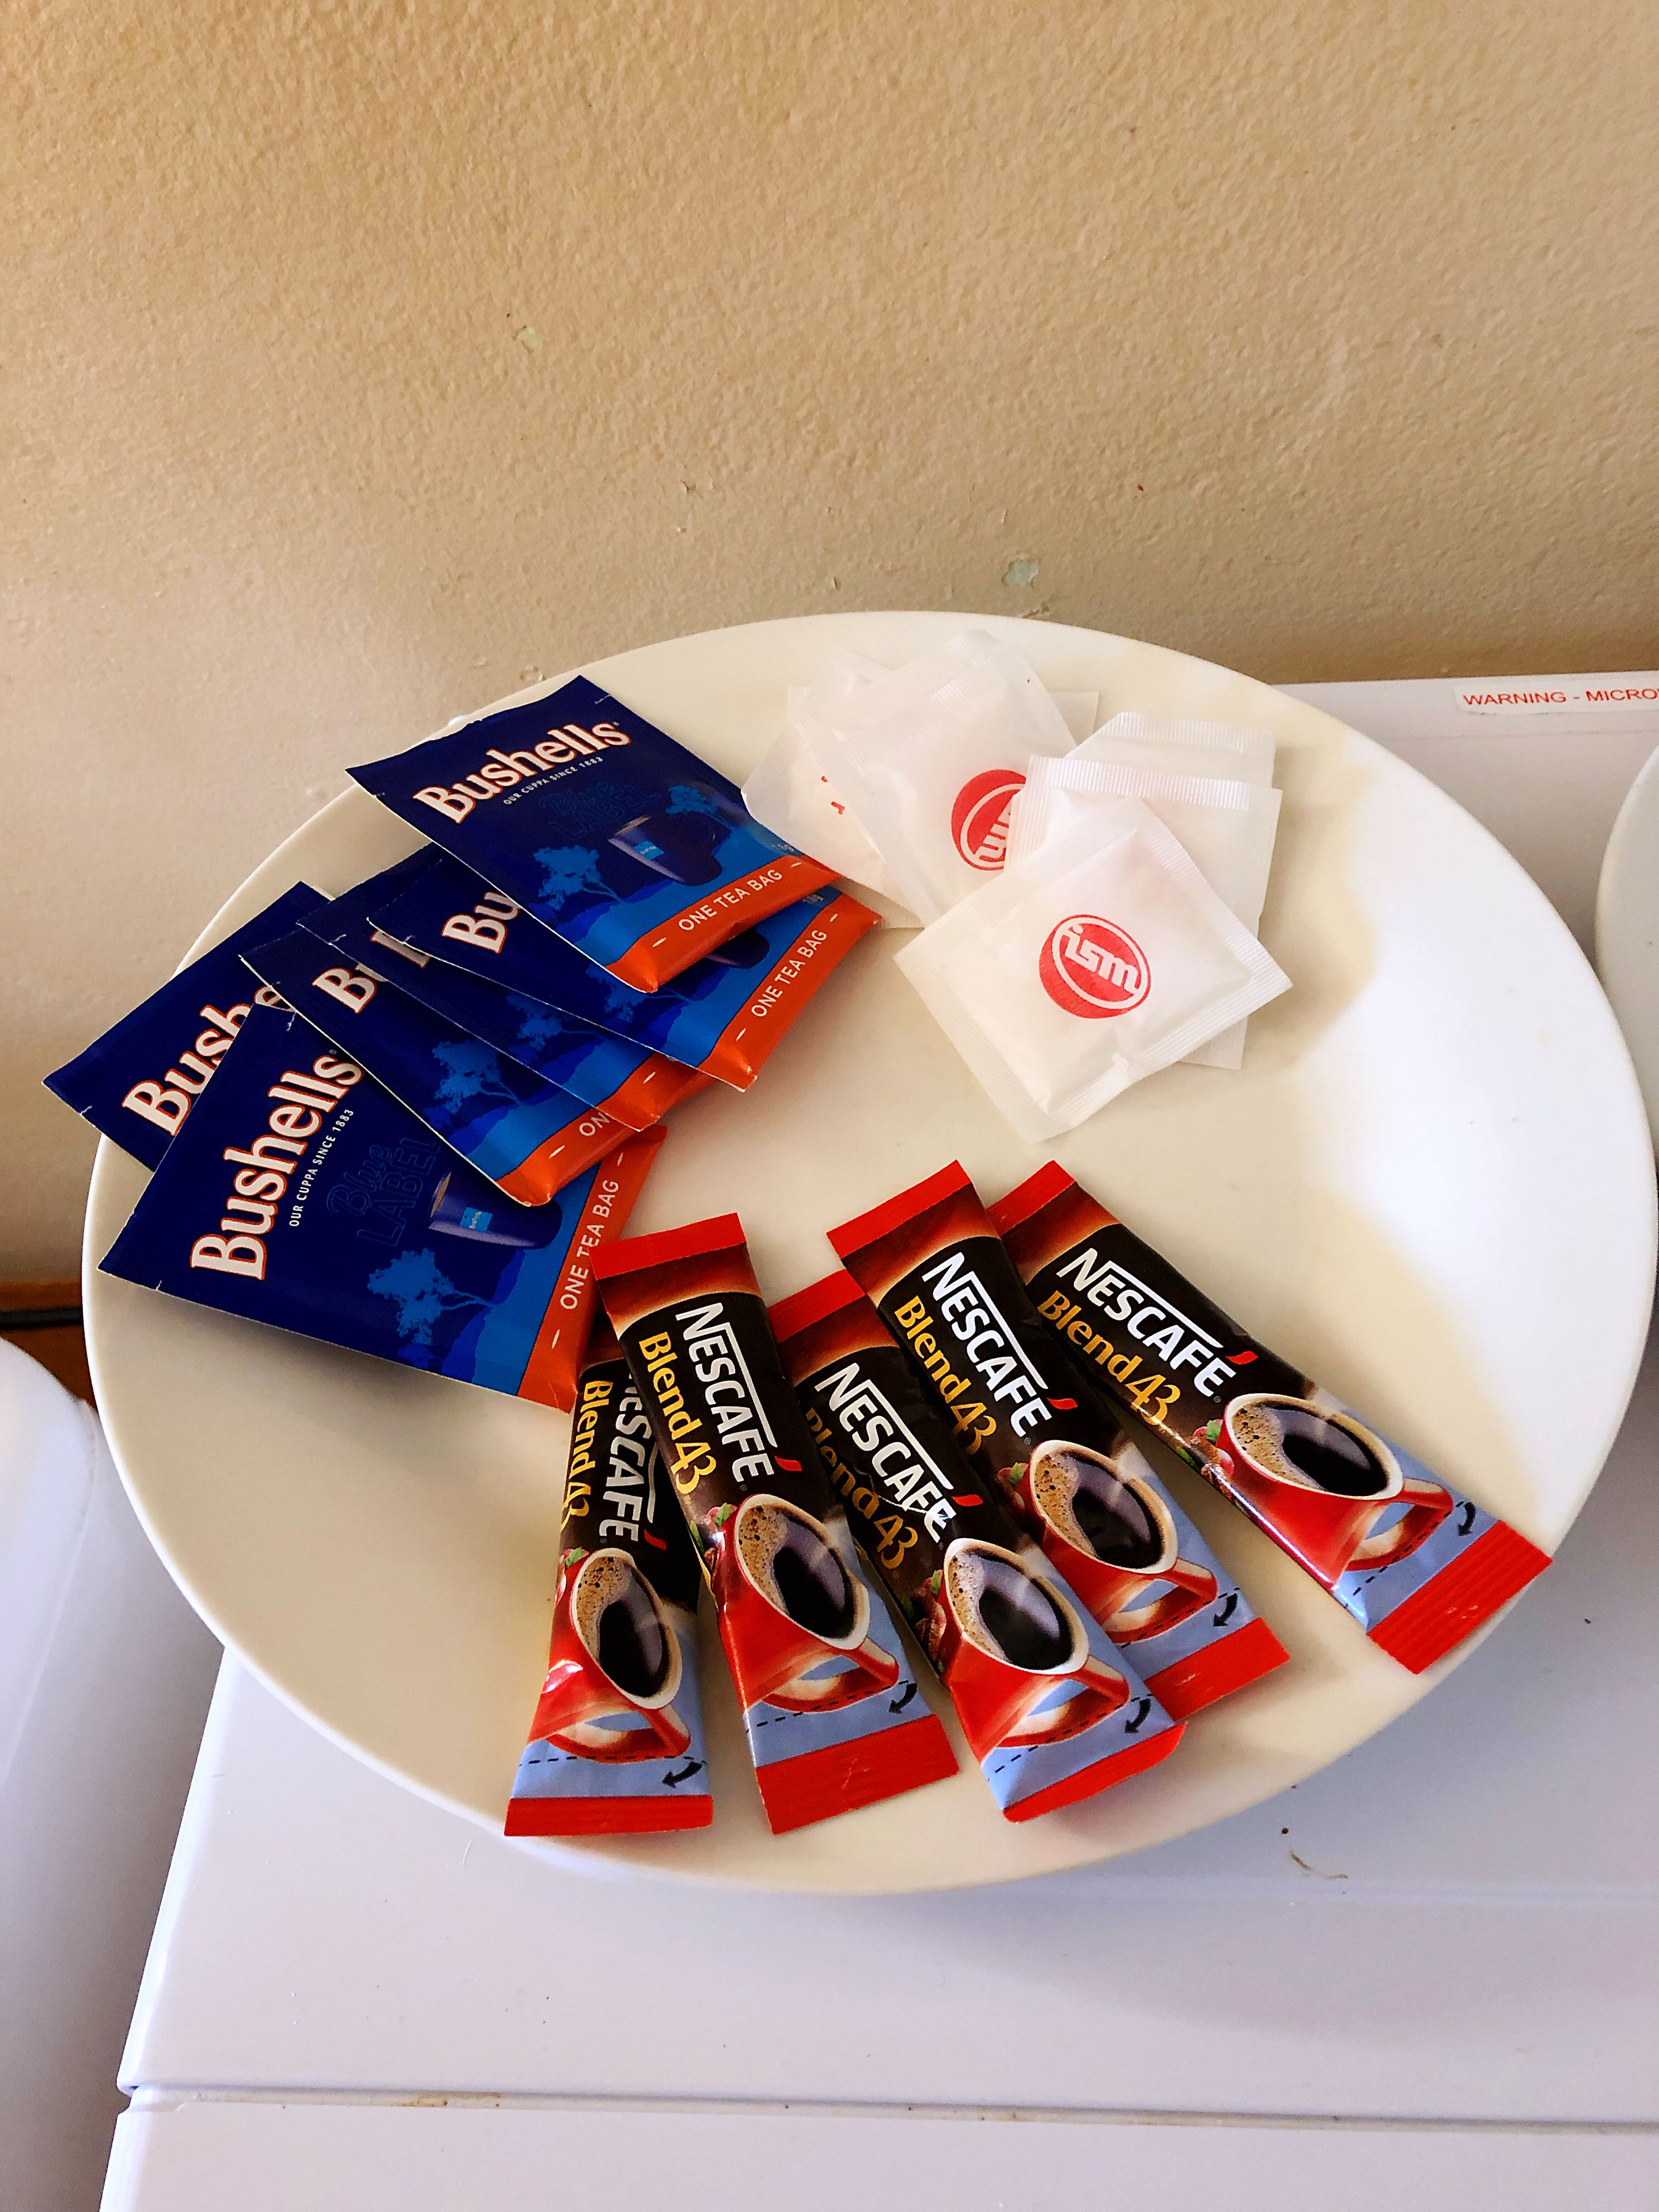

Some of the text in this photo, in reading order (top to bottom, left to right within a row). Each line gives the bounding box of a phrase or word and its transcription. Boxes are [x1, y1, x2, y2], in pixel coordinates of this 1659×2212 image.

[1463, 691, 1567, 706] WARNING
[1585, 688, 1659, 702] MICRO
[412, 721, 632, 824] Bushells
[503, 756, 603, 805] OUR CUPPA SINCE 1883
[679, 869, 782, 931] ONE TEA BAG
[751, 985, 783, 1017] ONE
[774, 959, 805, 984] TEA
[797, 930, 827, 958] BAG
[122, 985, 295, 1137] Bushe
[190, 1054, 365, 1281] Bushells
[289, 1109, 354, 1227] OUR CUPPA SINCE 1883
[579, 1112, 611, 1137] ON
[560, 1180, 619, 1310] ONE TEA BAG
[895, 1295, 997, 1455] Blend 43
[1037, 1290, 1180, 1425] Blend 43
[569, 1380, 613, 1479] Blend
[639, 1331, 717, 1494] Blend 43
[873, 1514, 918, 1569] 43
